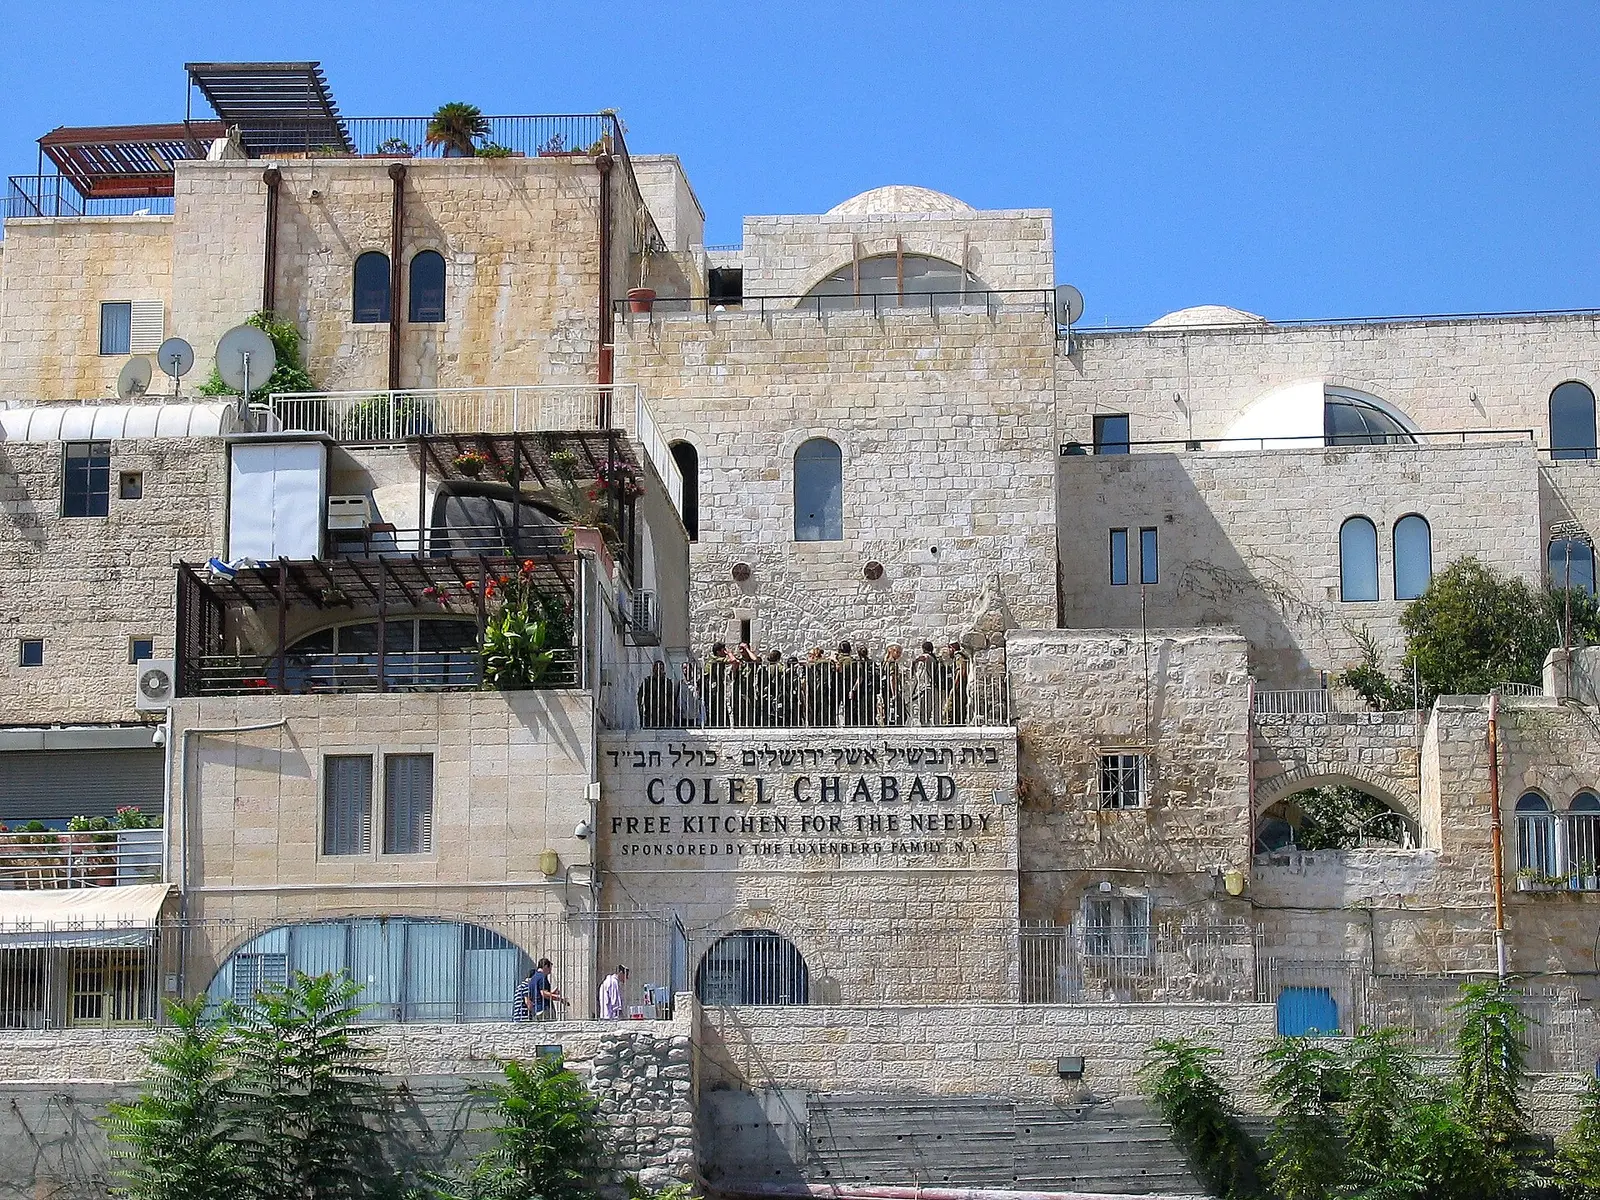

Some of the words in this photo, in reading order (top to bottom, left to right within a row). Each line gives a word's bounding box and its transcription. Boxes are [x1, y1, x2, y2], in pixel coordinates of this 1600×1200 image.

[668, 743, 717, 768] כולל
[742, 743, 824, 767] ירושלים
[884, 741, 954, 765] תבשיל
[961, 747, 998, 765] בית
[647, 778, 773, 805] COLEL
[794, 774, 956, 803] CHABAD
[611, 816, 671, 834] FREE
[682, 815, 788, 834] KITCHEN
[801, 815, 842, 833] FOR
[854, 814, 899, 832] THE
[910, 813, 992, 832] NEEDY
[621, 844, 718, 856] SPONSORED
[726, 843, 745, 855] BY
[753, 843, 784, 855] THE
[789, 842, 881, 855] LUXENBERG
[891, 841, 942, 854] FAMILY
